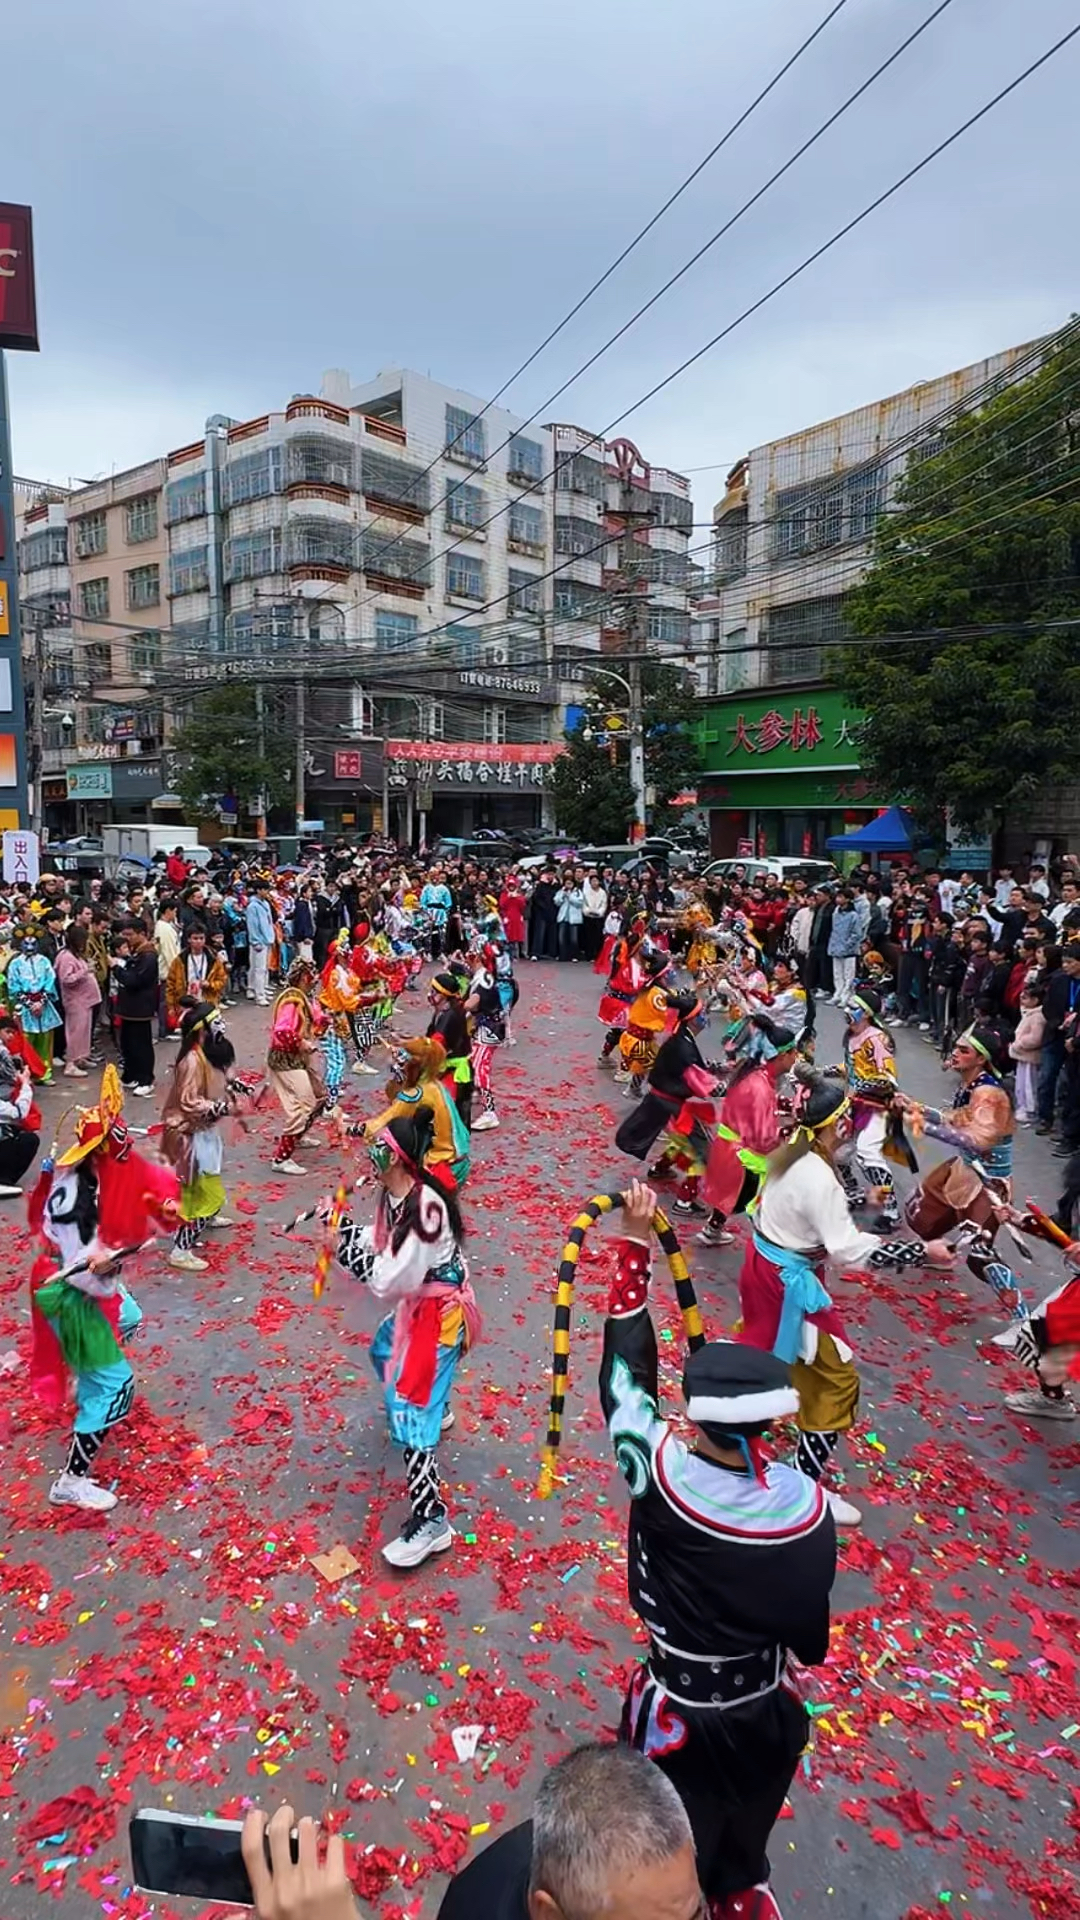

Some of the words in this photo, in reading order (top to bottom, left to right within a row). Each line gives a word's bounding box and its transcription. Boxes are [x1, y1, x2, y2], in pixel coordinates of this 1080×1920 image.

[725, 706, 824, 757] 大参林
[14, 840, 28, 882] 出入口
